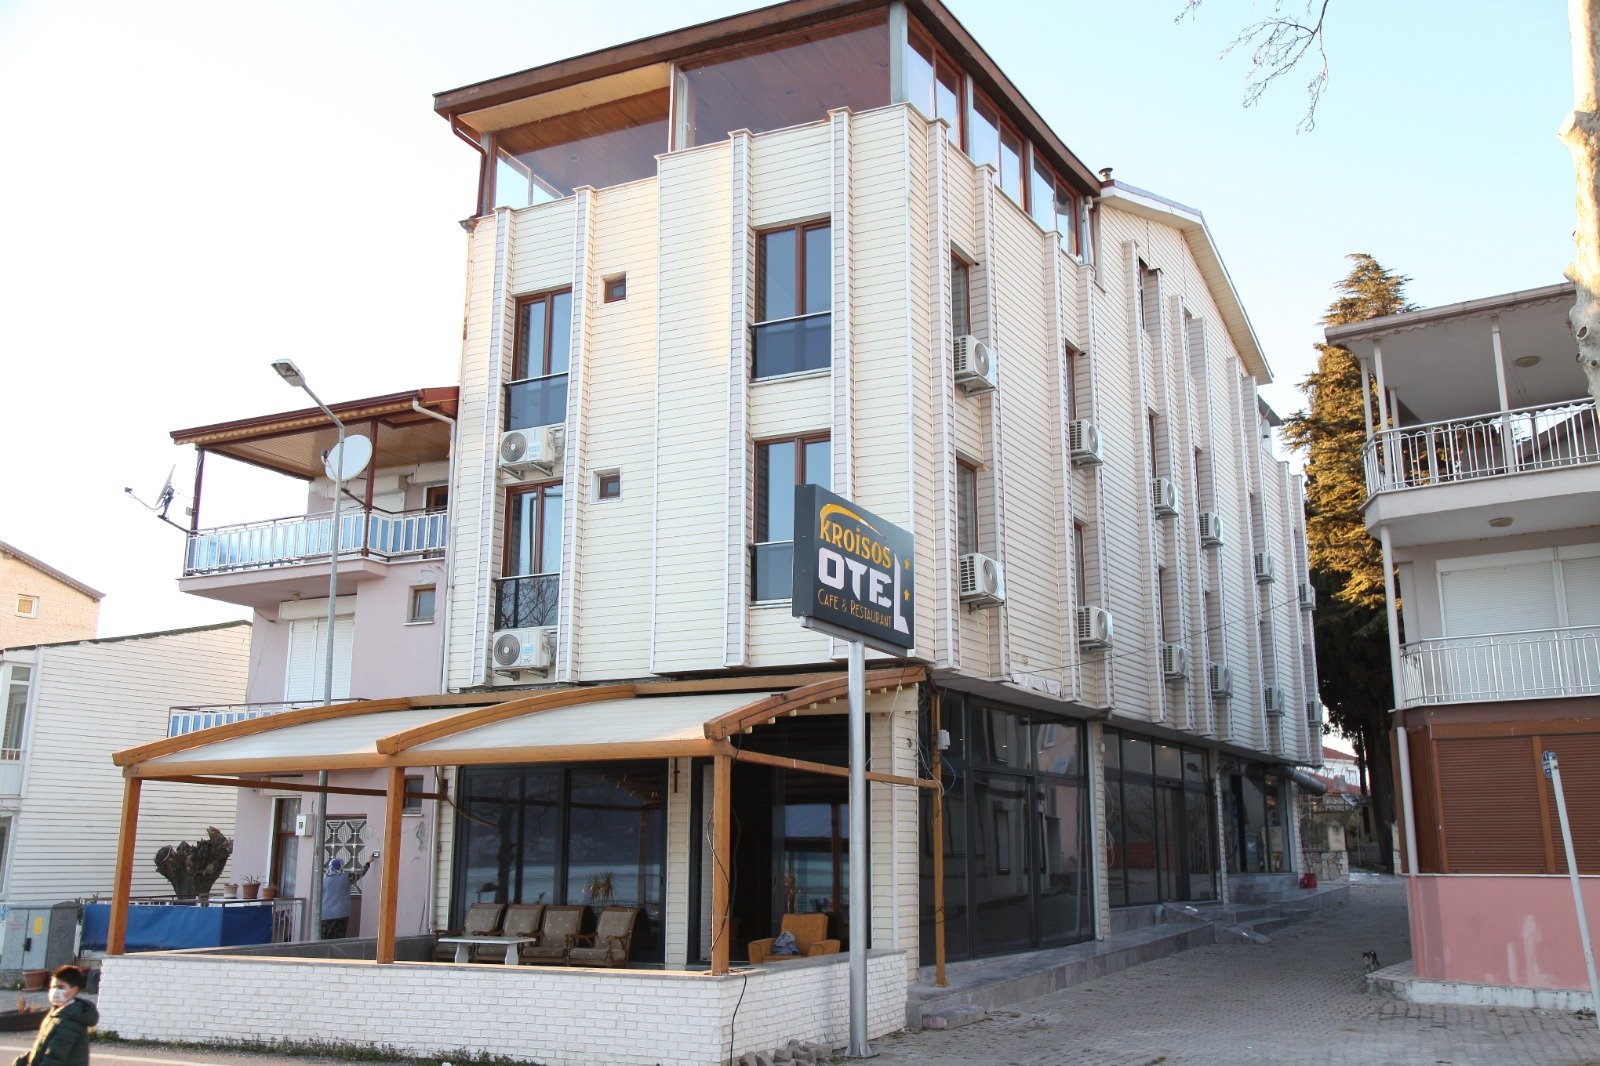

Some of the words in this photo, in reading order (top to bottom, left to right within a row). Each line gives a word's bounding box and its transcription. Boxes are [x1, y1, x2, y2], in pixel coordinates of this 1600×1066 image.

[817, 588, 839, 610] CAFE
[841, 600, 847, 613] &
[850, 599, 892, 628] RESTAURANT
[818, 547, 910, 635] OTEL
